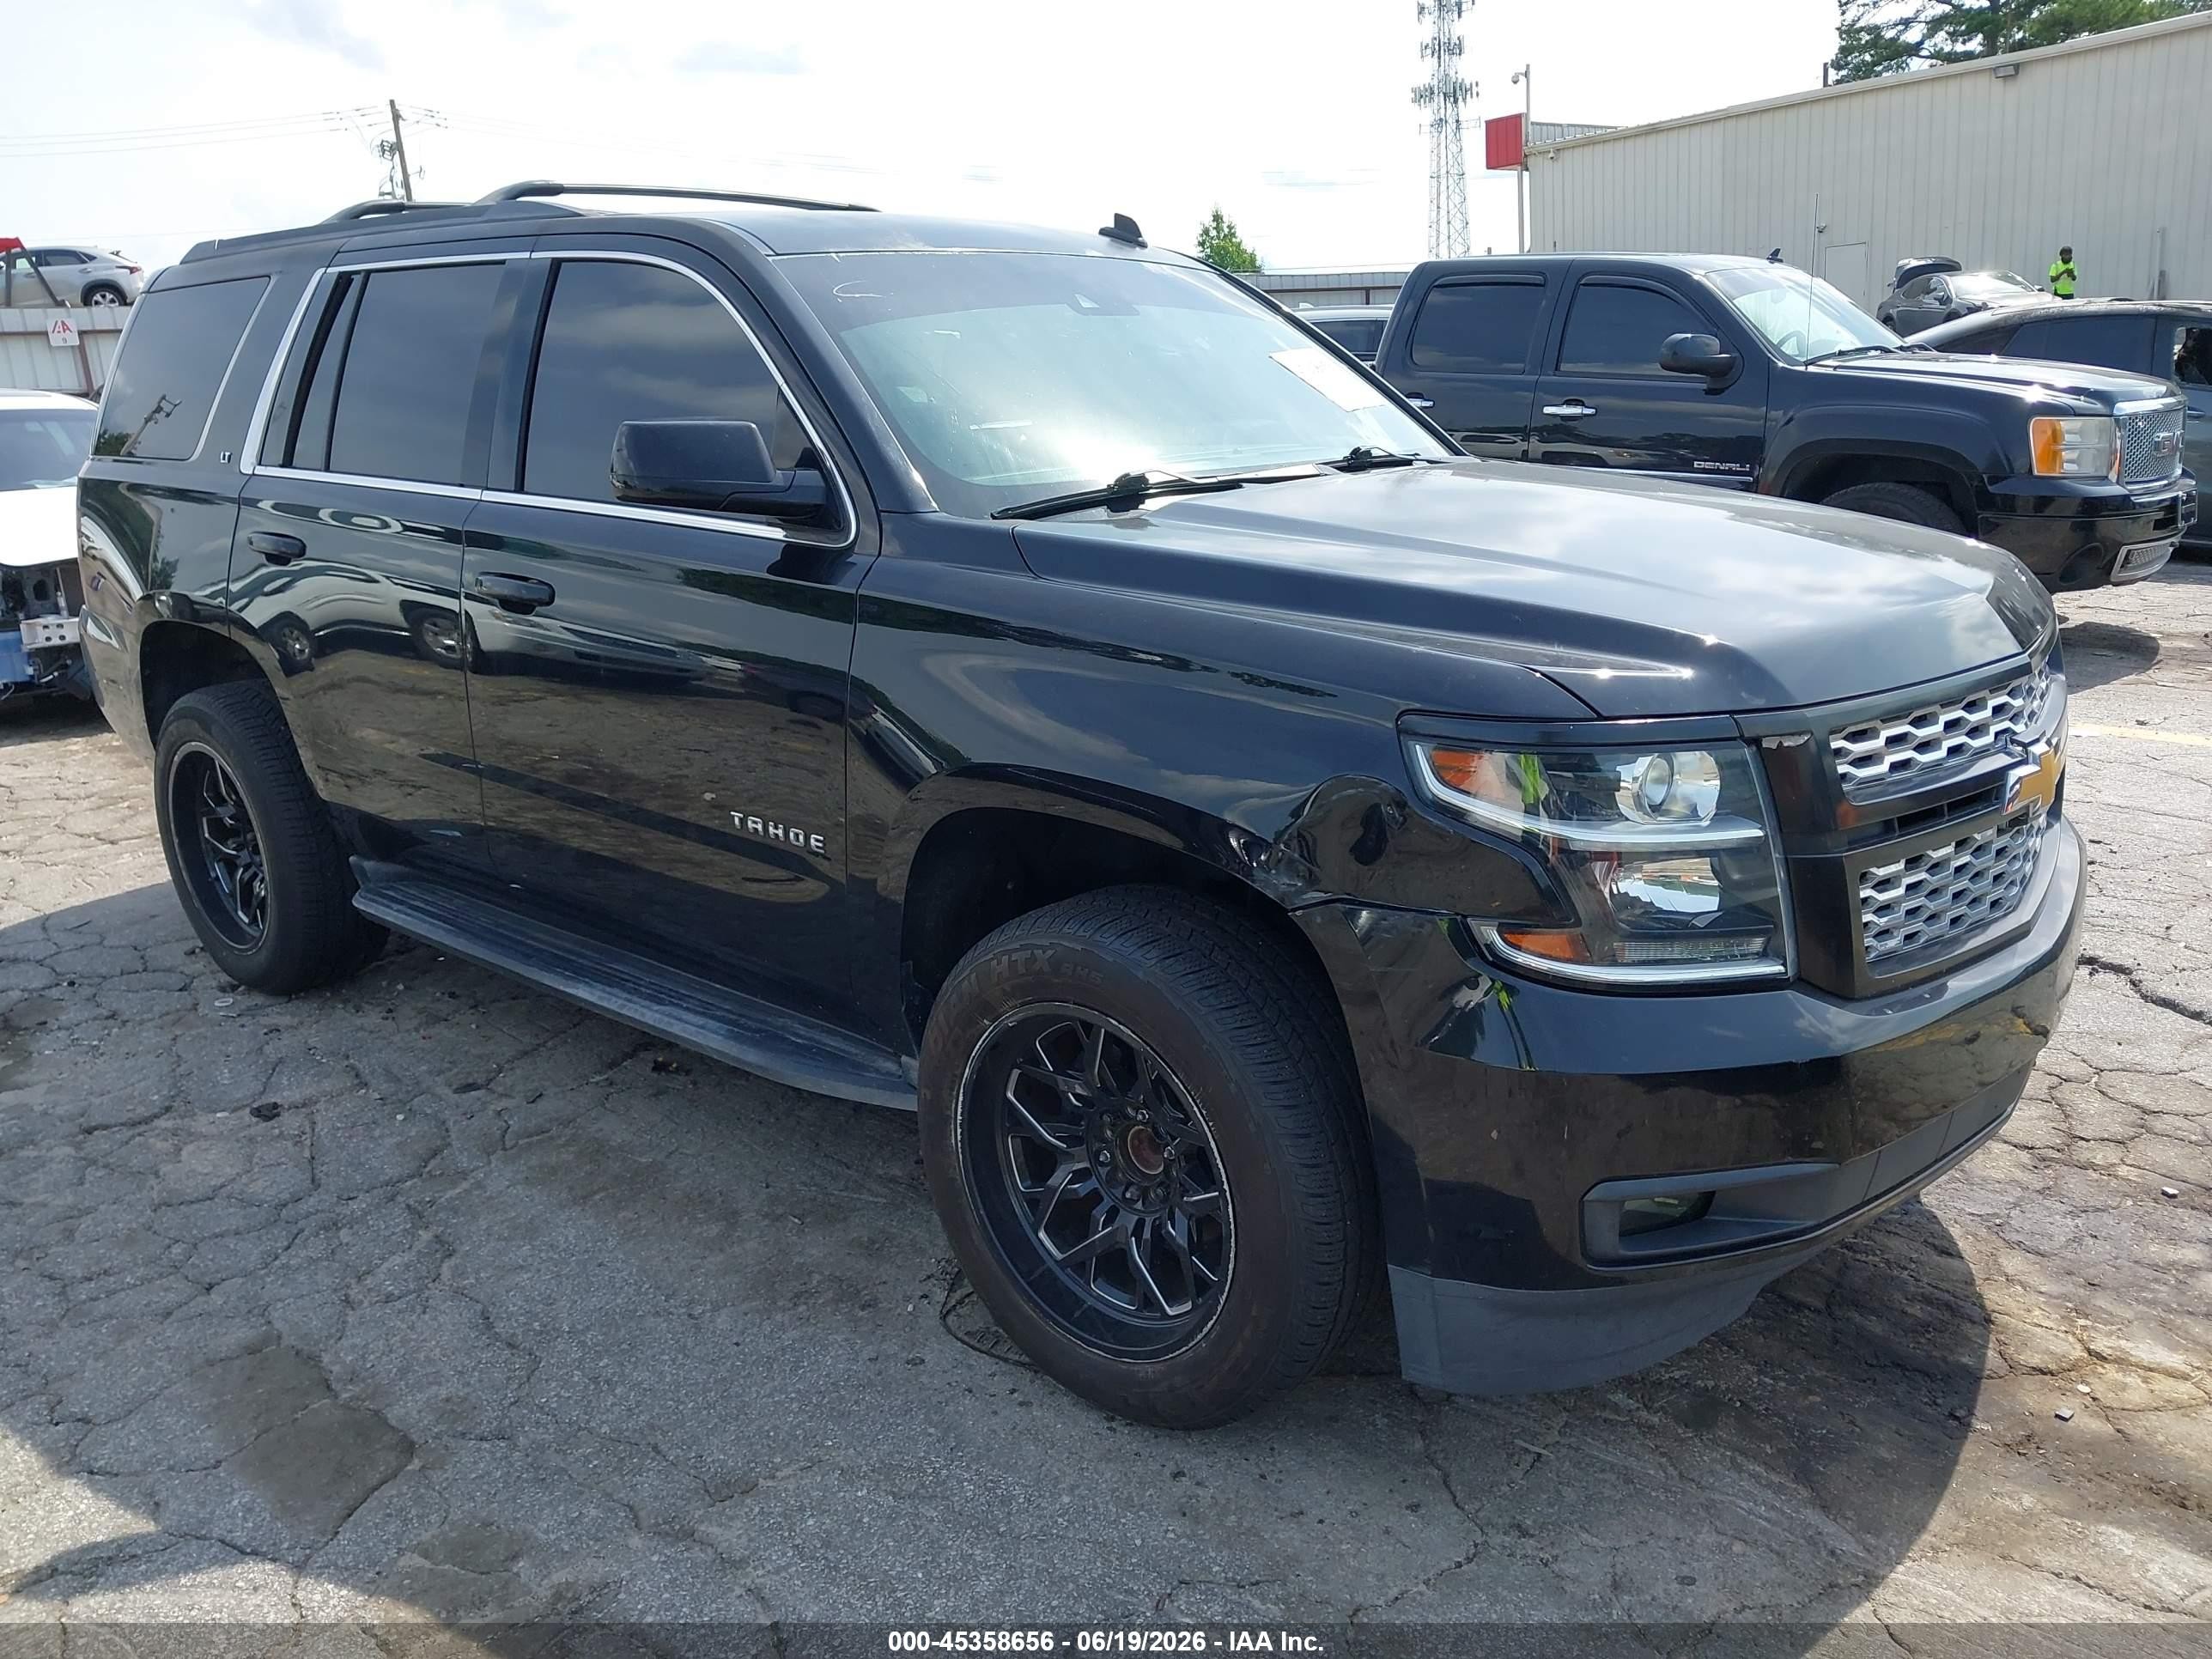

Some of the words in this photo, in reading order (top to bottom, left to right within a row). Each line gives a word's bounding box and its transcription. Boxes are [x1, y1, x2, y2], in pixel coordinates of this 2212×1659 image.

[220, 451, 232, 464] LT
[1693, 460, 1750, 471] DENALI
[729, 811, 826, 854] TAHOE
[990, 949, 1058, 981] HTX
